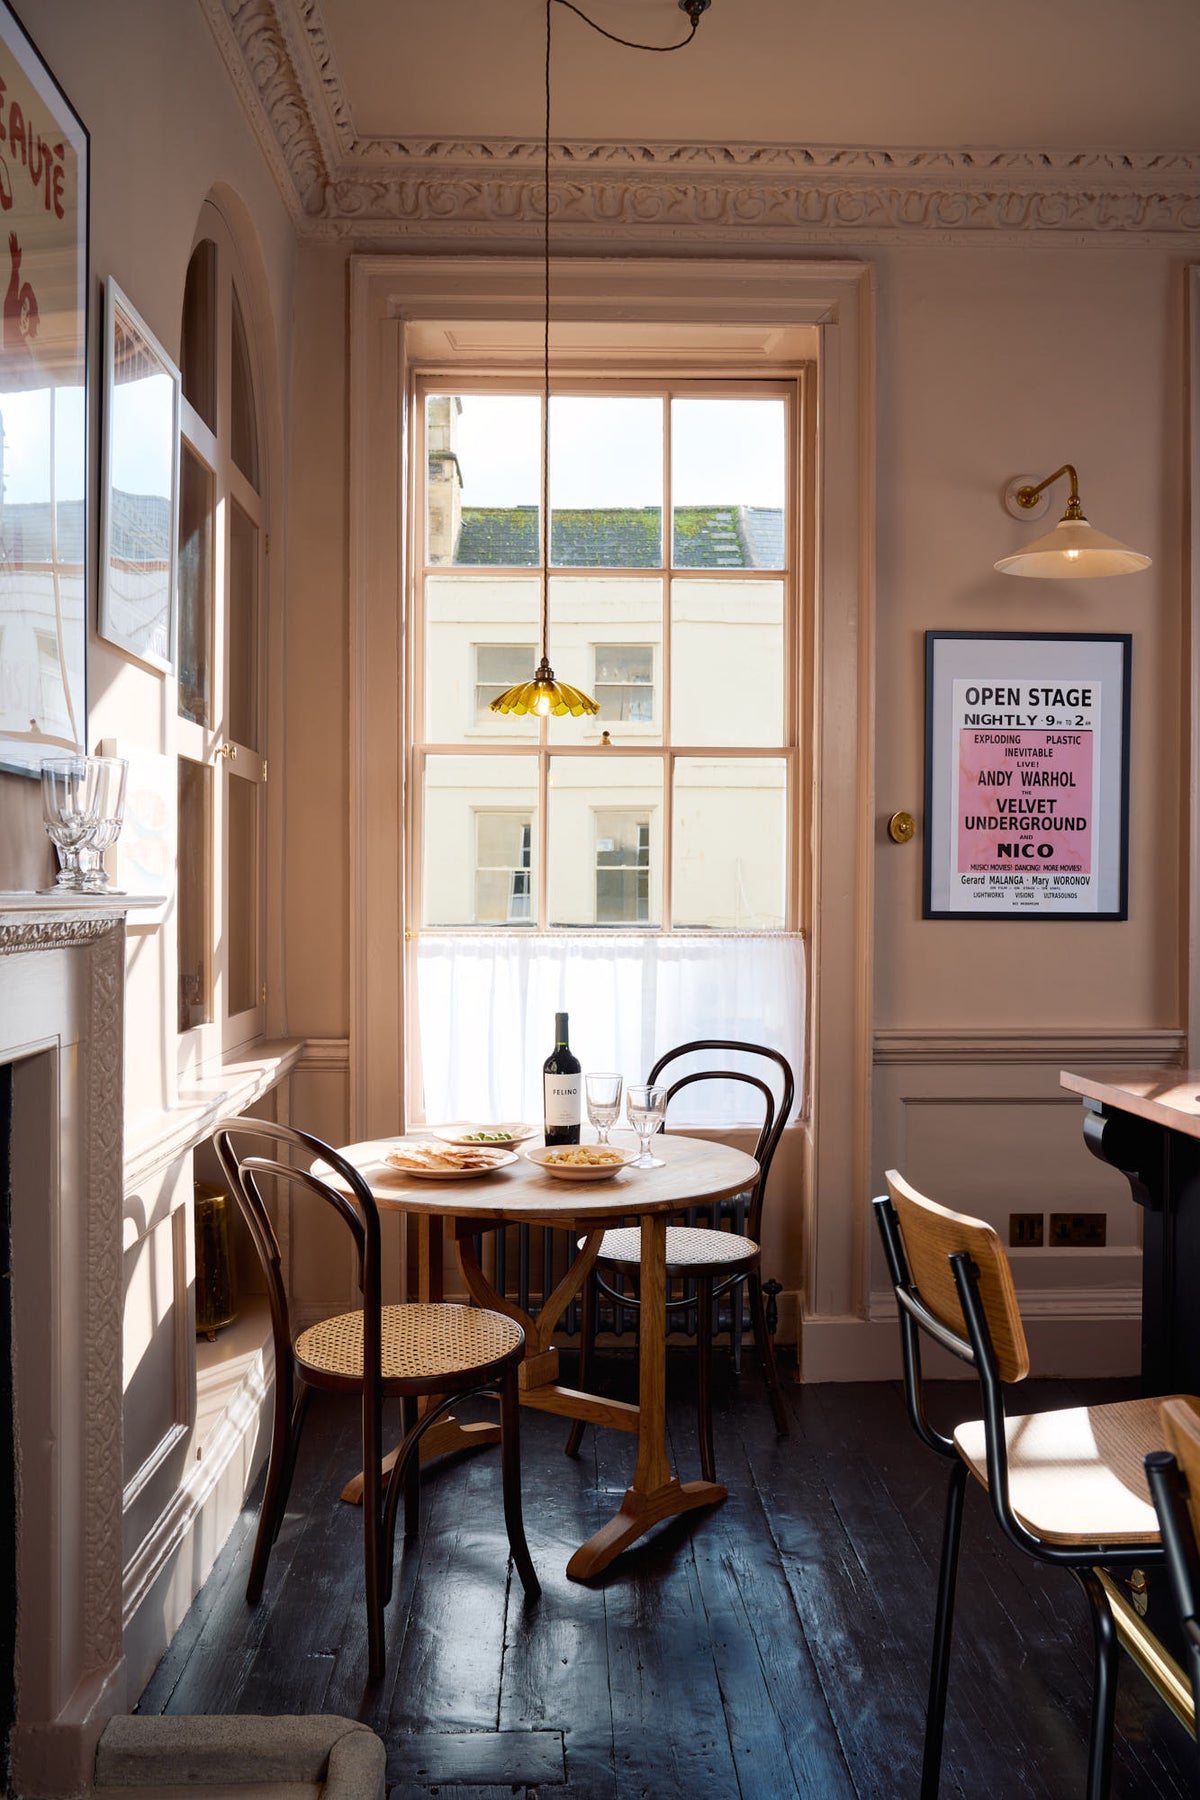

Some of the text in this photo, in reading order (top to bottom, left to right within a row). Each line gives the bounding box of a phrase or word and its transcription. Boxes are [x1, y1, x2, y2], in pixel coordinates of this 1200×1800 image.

[965, 687, 1092, 707] OPEN STAGE
[964, 714, 1038, 726] NIGHTLY
[974, 734, 1081, 745] EXPLODING PLASTIC
[1005, 748, 1053, 757] INEVITABLE
[978, 771, 1076, 787] ANDY WARHOL
[996, 798, 1057, 814] VELVET
[965, 816, 1087, 831] UNDERGROUND
[997, 844, 1054, 858] NICO
[961, 875, 1090, 887] Gerard MALANGA Mary WORONOV
